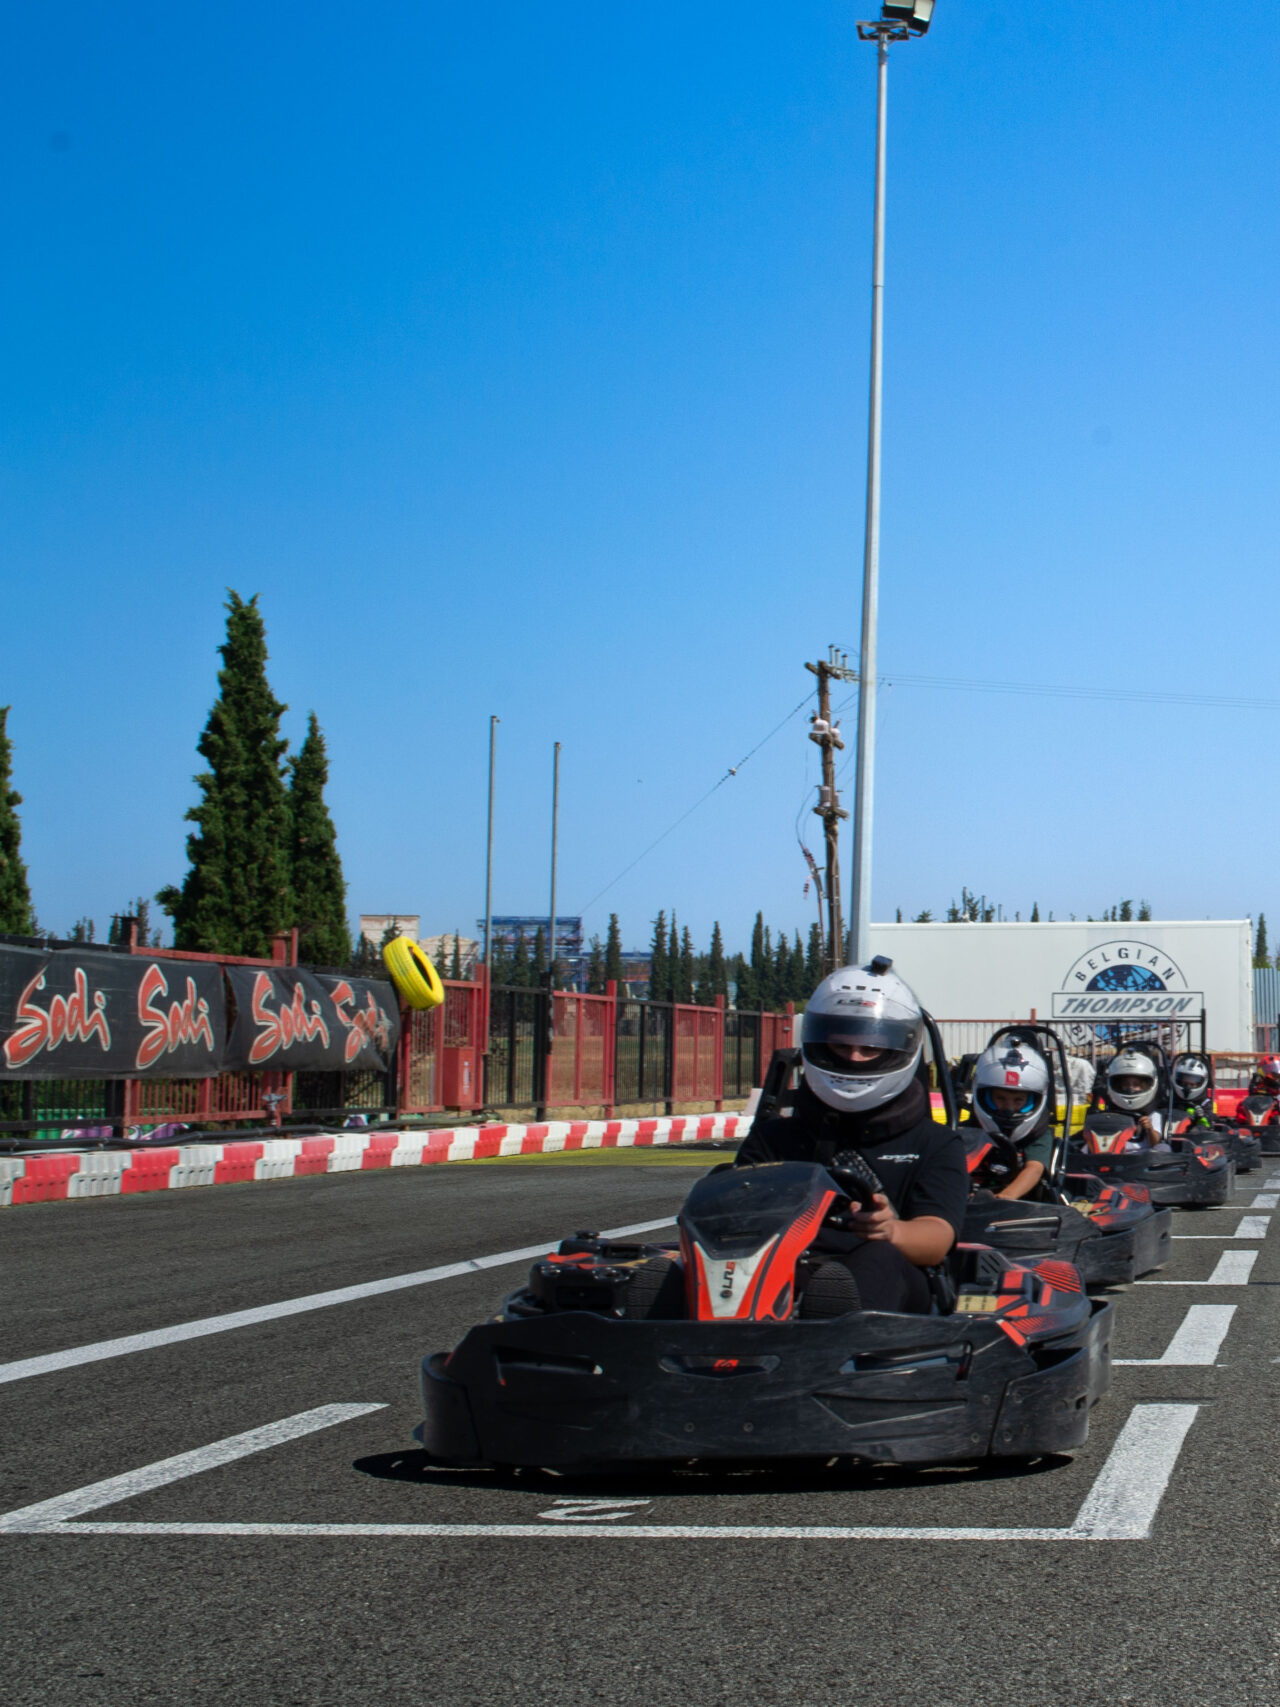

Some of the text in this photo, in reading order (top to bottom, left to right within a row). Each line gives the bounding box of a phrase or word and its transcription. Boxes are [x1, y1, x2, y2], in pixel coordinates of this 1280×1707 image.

[1060, 997, 1193, 1014] THOMPSON
[1075, 947, 1176, 982] BELGIAN
[3, 966, 111, 1069] Sodi
[136, 963, 215, 1069] Sodi
[249, 970, 329, 1064] Sodi
